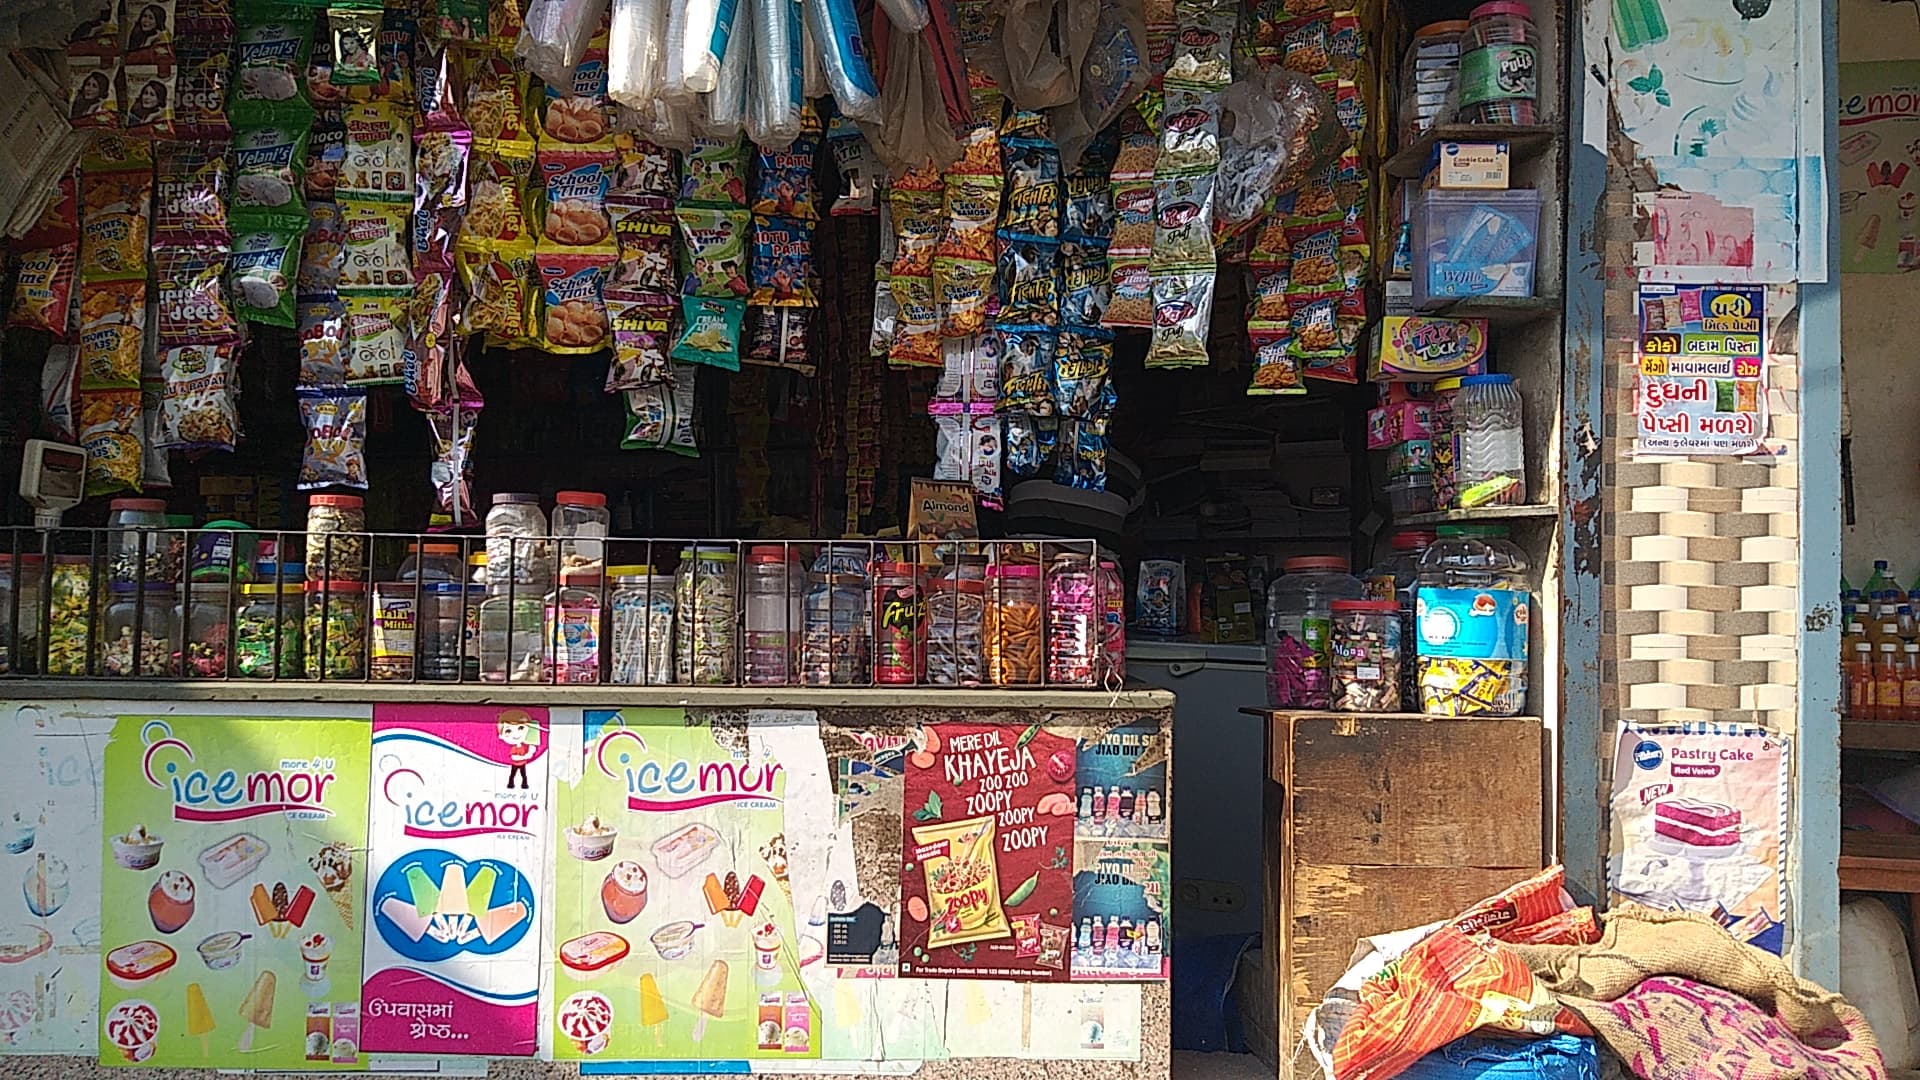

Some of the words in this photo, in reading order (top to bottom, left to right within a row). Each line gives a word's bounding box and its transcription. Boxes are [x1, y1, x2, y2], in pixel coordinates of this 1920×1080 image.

[241, 42, 297, 60] Velani's
[499, 74, 520, 131] Noodles
[237, 147, 290, 167] Velani's
[549, 171, 602, 188] School
[560, 185, 598, 198] Time
[500, 176, 520, 232] Noodles
[957, 209, 990, 217] SAMOSA
[959, 202, 977, 210] SEV
[616, 219, 673, 236] SHIVA
[1167, 222, 1192, 244] Puff
[232, 250, 281, 272] Velani's
[549, 272, 601, 291] School
[558, 284, 597, 300] Time
[1715, 297, 1745, 317] પરી
[611, 318, 668, 333] SHIVA
[1162, 323, 1185, 341] Puff
[1645, 336, 1677, 353] કોકો
[1687, 340, 1720, 352] બદામ
[1643, 411, 1690, 433] પેપ્સી
[1699, 412, 1753, 434] મળશે
[923, 500, 969, 513] Almond
[949, 733, 983, 753] MERE
[984, 730, 1003, 747] DIL
[1122, 734, 1140, 746] DIL
[281, 760, 308, 770] more
[312, 760, 320, 769] 4
[325, 759, 334, 769] U
[944, 745, 1037, 782] KHAYEJA
[1671, 747, 1717, 764] Pastry
[1719, 748, 1754, 761] Cake
[167, 762, 335, 804] icemor
[980, 775, 1003, 793] ZOO
[1005, 771, 1029, 788] ZOO
[966, 789, 1013, 816] ZOOPY
[1643, 783, 1670, 803] NEW
[405, 792, 539, 828] icemor
[998, 806, 1035, 827] ZOOPY
[1002, 825, 1049, 852] ZOOPY
